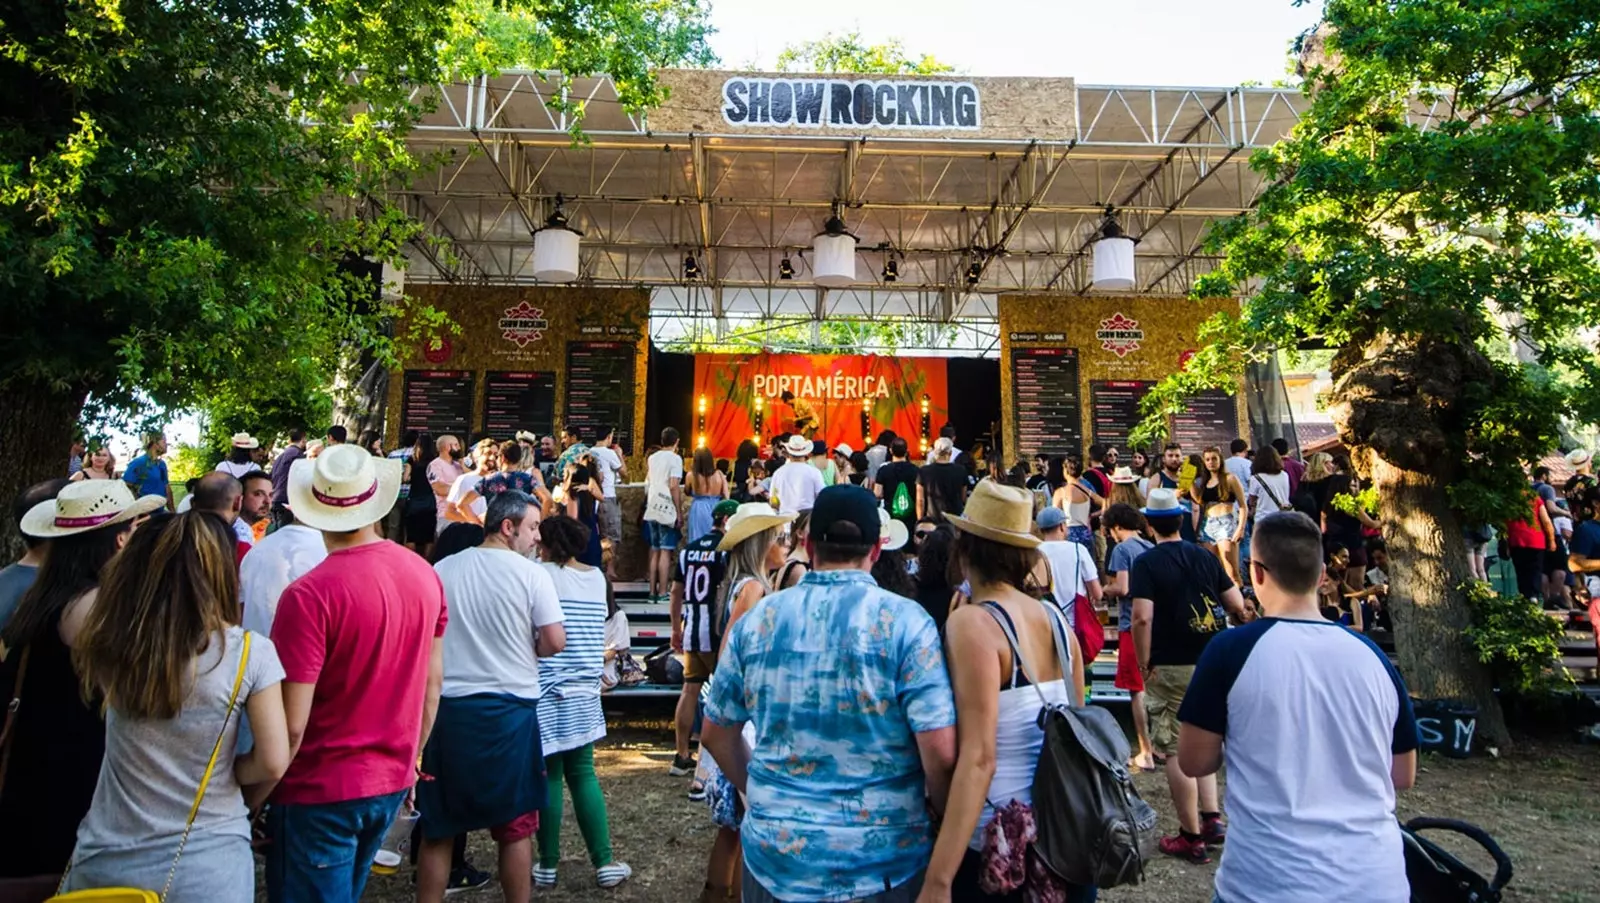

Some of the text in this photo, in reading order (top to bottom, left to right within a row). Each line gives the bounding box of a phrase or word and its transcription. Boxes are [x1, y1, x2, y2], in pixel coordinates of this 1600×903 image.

[725, 81, 978, 127] SHOW ROCKING
[1097, 330, 1143, 339] SHOW ROCKING
[753, 370, 890, 397] PORTAMÉRICA
[685, 564, 710, 602] 10
[1453, 718, 1476, 752] M
